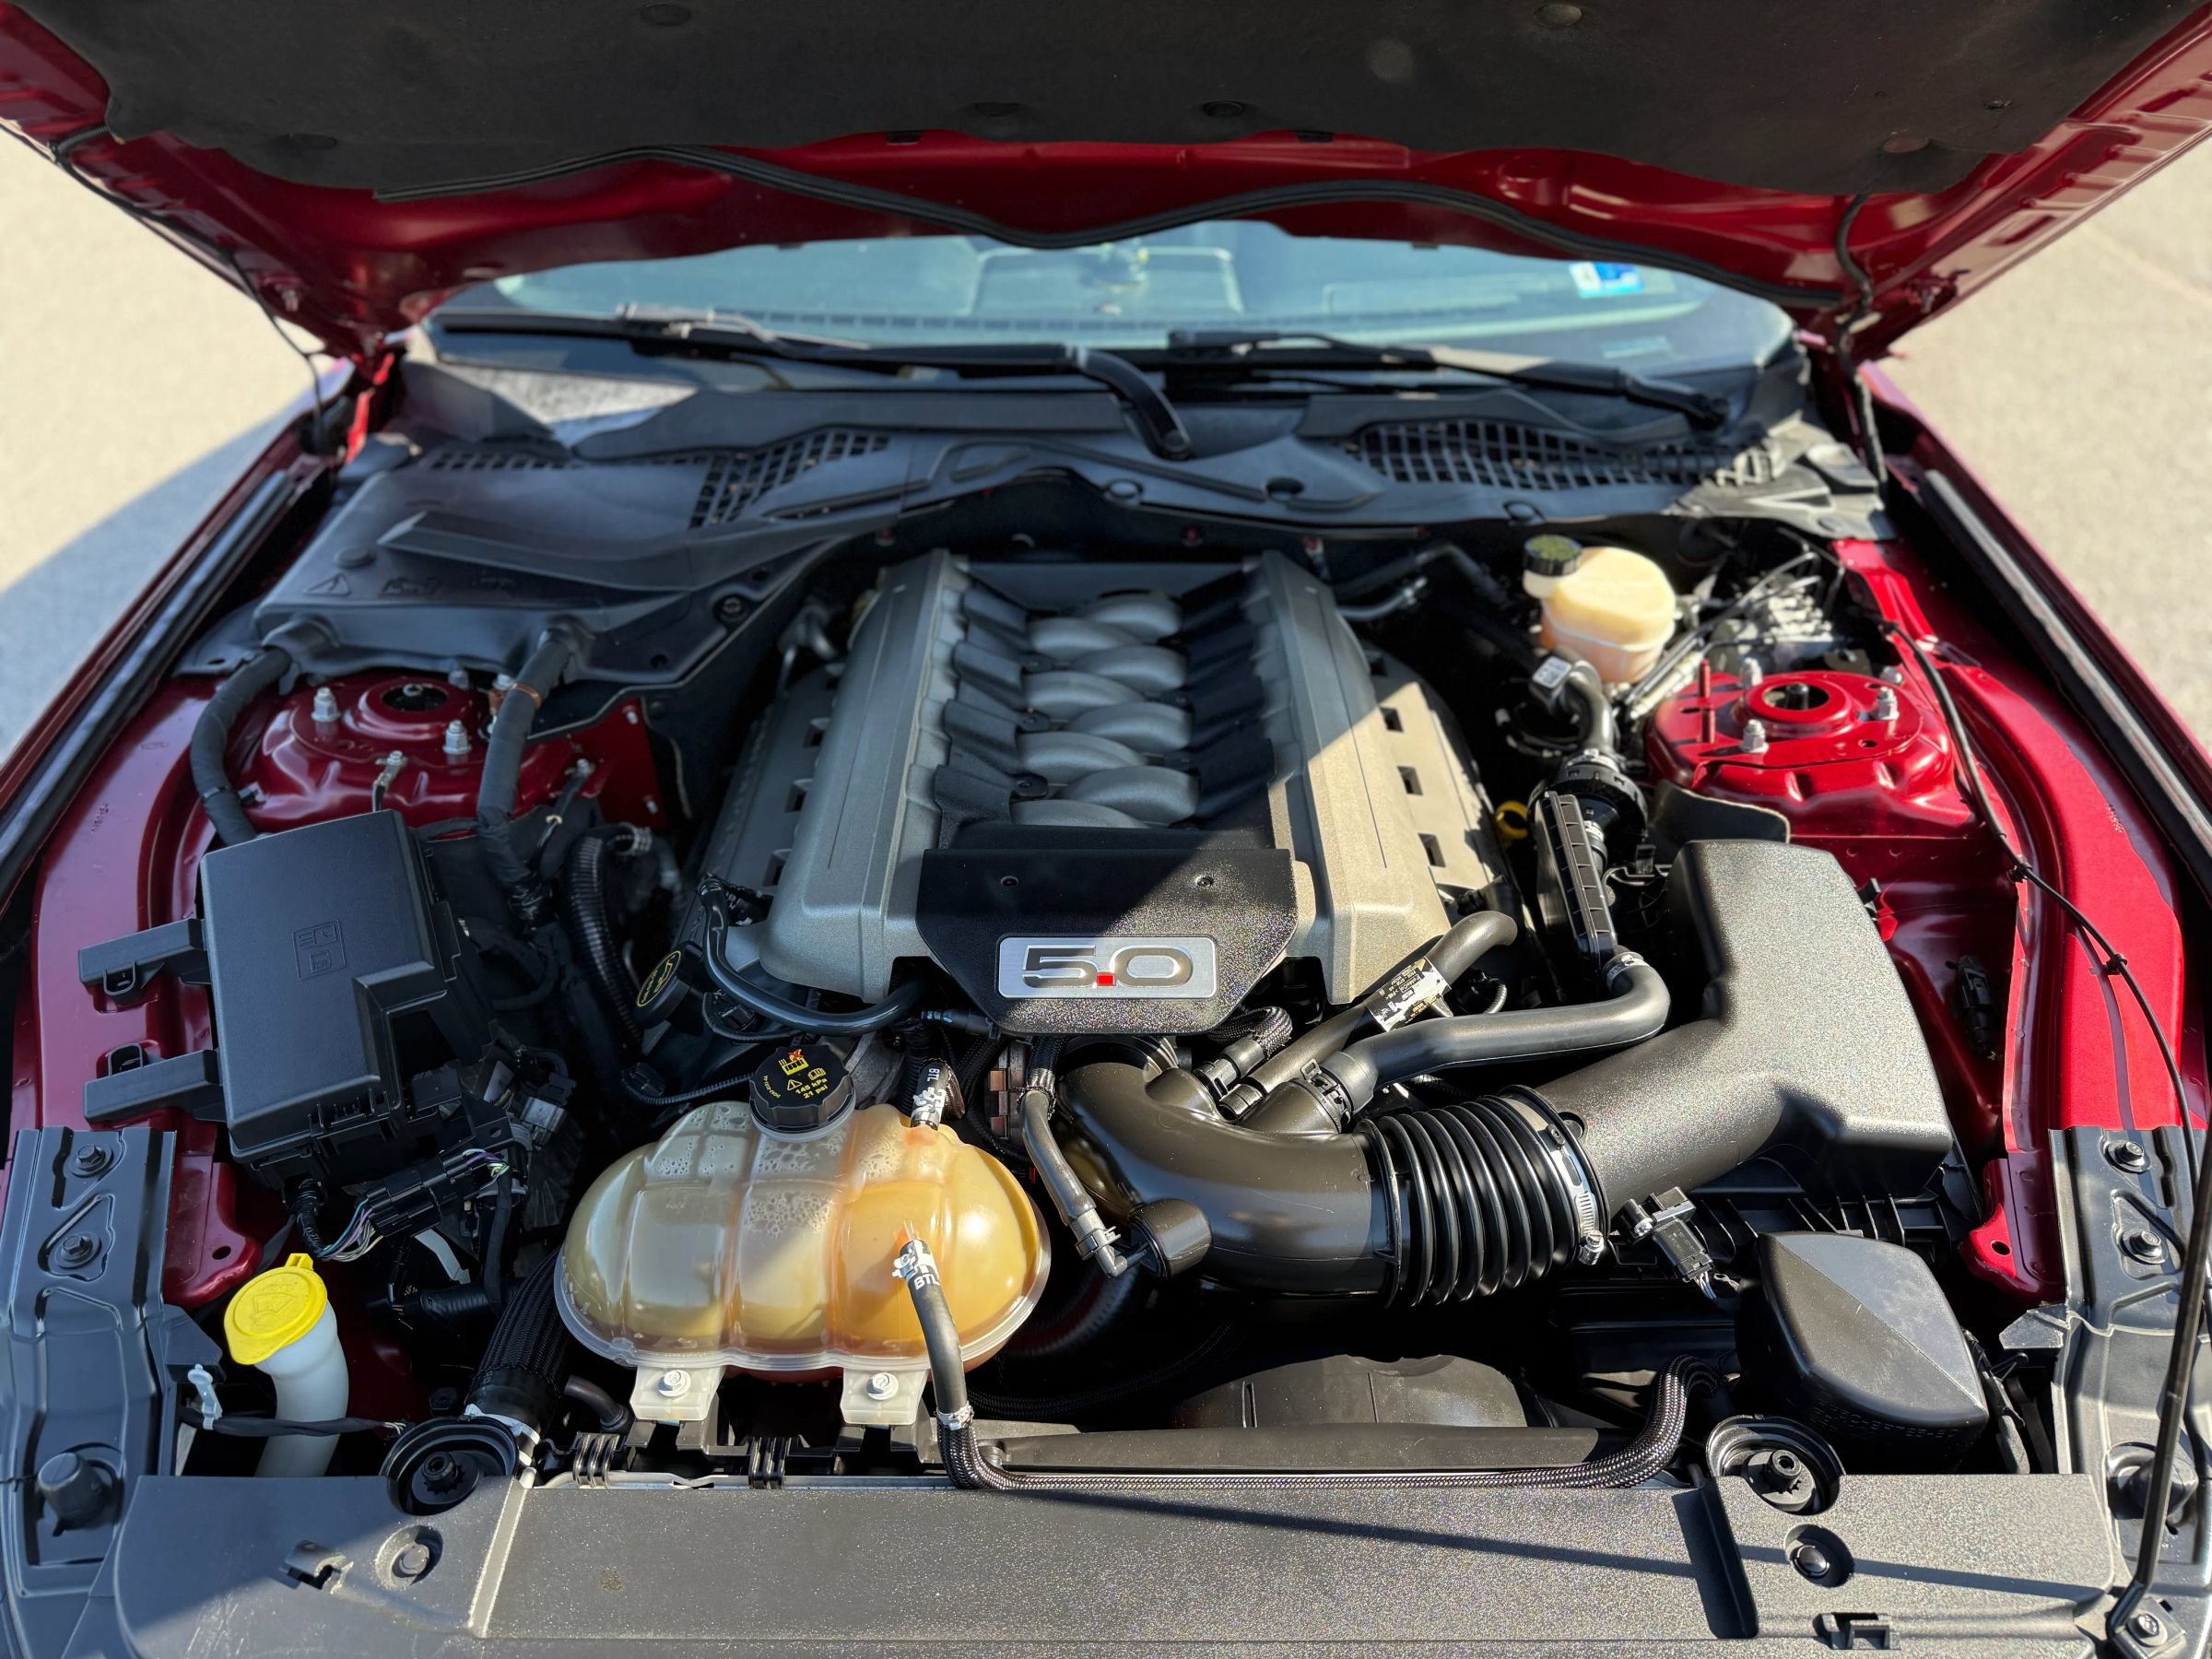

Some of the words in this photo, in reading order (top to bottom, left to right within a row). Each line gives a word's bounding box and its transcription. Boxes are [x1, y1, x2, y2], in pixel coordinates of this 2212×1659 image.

[1022, 945, 1194, 988] 5.0
[927, 1068, 940, 1082] BTL
[794, 1084, 811, 1095] 145
[811, 1077, 828, 1088] kPa
[803, 1090, 814, 1100] 21
[815, 1084, 829, 1095] psi
[913, 1273, 941, 1290] BTL
